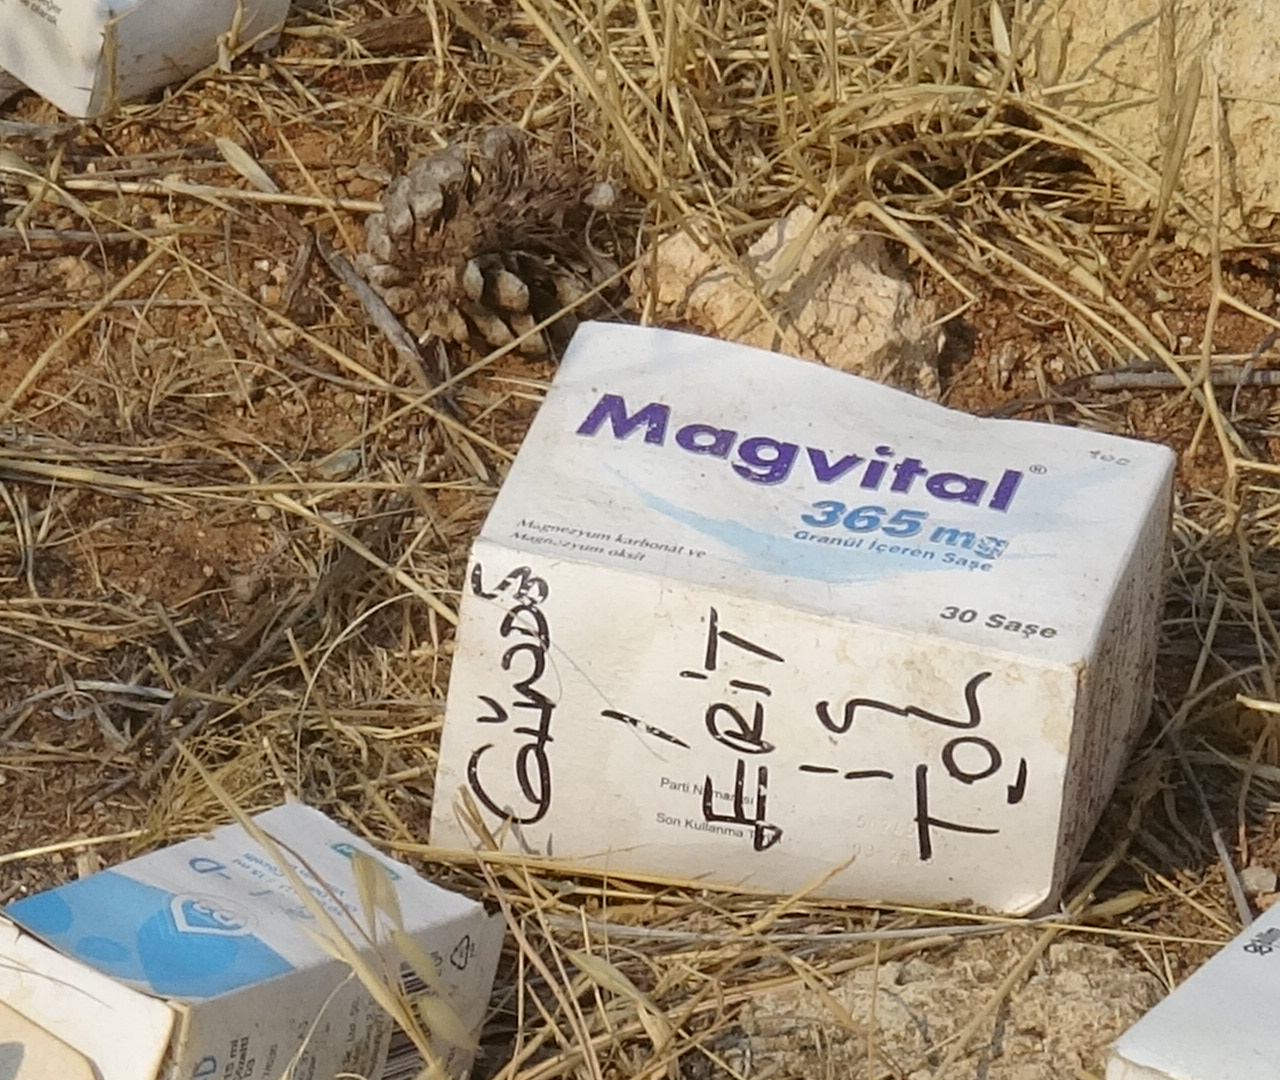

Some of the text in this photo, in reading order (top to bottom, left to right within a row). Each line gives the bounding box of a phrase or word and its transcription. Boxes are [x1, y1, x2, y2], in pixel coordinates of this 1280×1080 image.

[575, 392, 1024, 513] Magvital
[801, 500, 1010, 560] 365 mg
[608, 547, 647, 562] oksit
[614, 533, 684, 555] karbonat
[687, 548, 707, 560] ve
[793, 529, 993, 573] Granül İçeren Saşe
[939, 605, 1058, 640] 30 Saşe
[660, 776, 691, 792] Parti
[655, 811, 680, 828] Son
[684, 815, 745, 838] Kullanma
